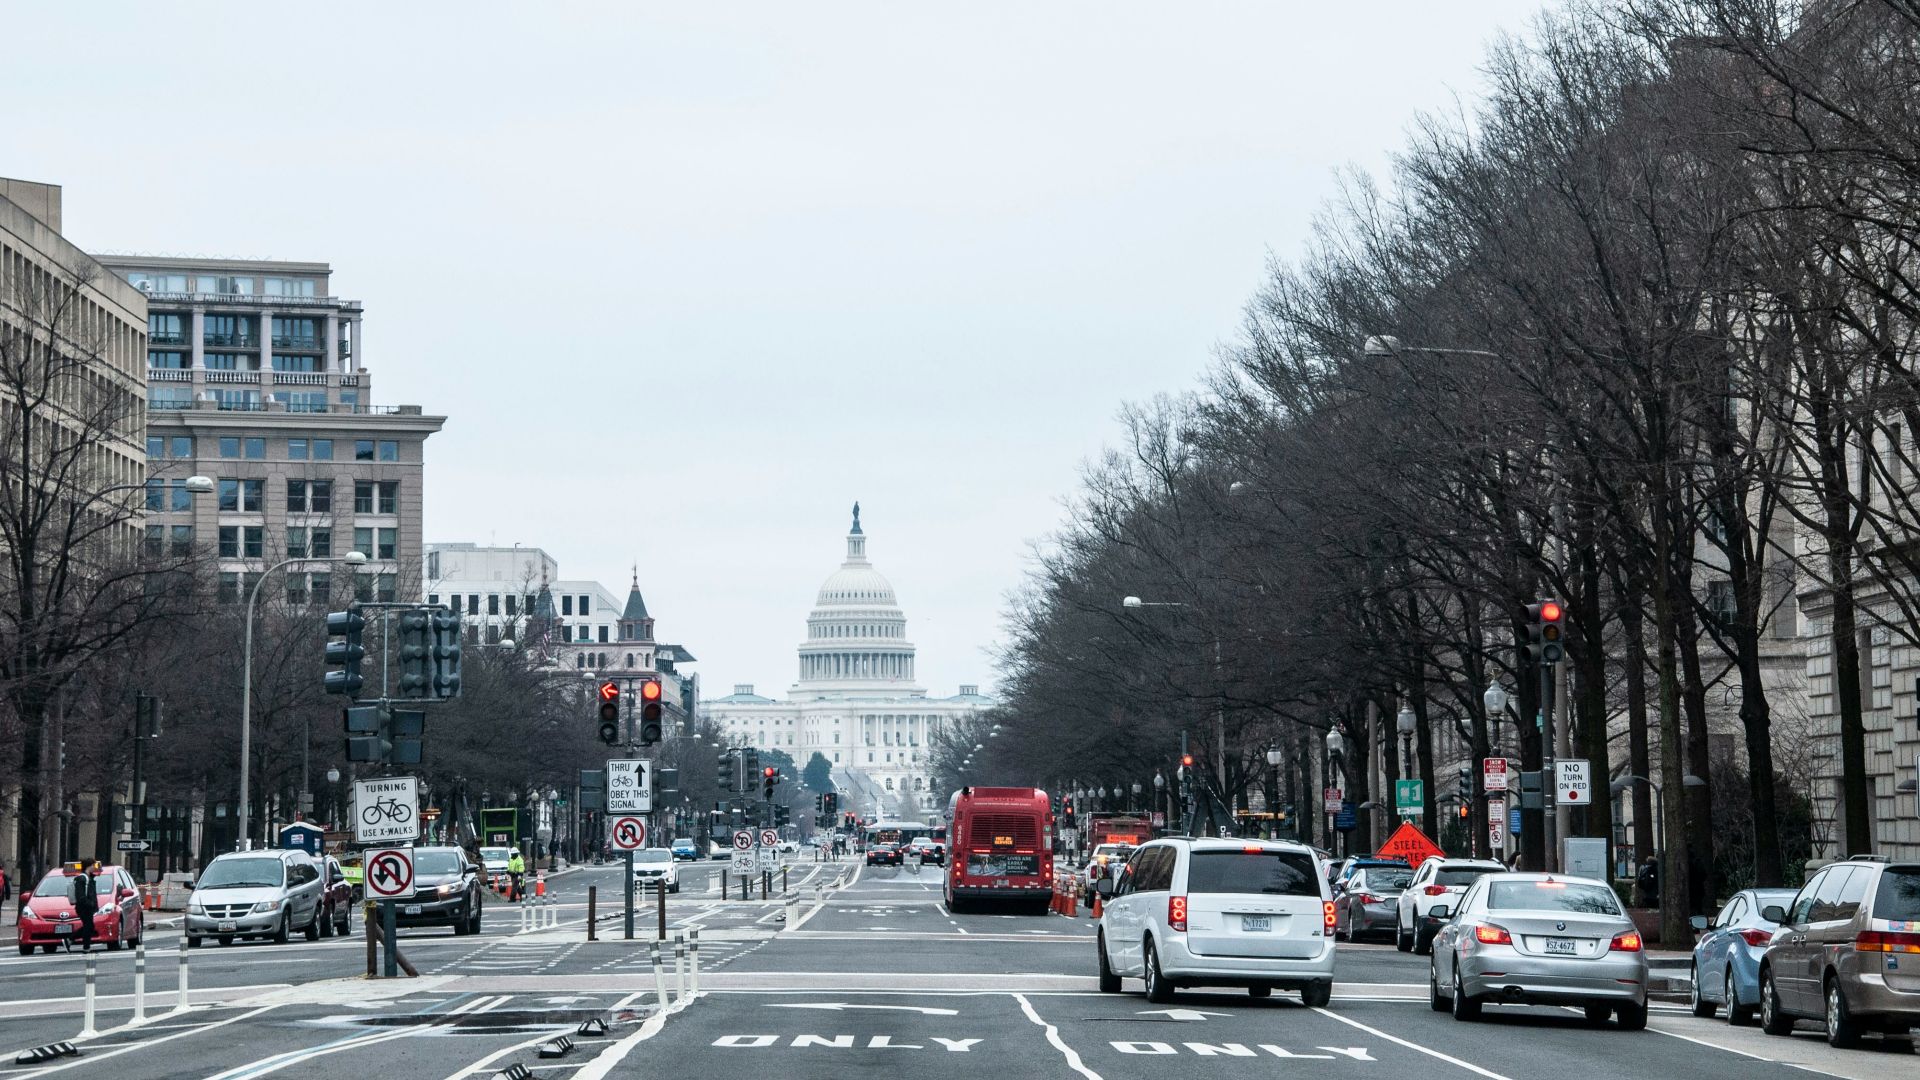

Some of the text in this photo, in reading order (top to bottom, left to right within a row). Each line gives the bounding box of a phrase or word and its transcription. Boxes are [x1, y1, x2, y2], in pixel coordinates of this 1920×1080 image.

[611, 763, 630, 771] THRU
[1565, 764, 1580, 772] NO
[365, 783, 407, 793] TURNING
[610, 790, 649, 799] OBEY THIS
[610, 801, 637, 809] SIGNAL
[362, 826, 413, 837] USE X-WALKS
[1393, 840, 1424, 850] STEEL
[1392, 852, 1427, 862] ATES
[711, 1034, 984, 1051] ONLY
[1109, 1042, 1378, 1061] ONLY
